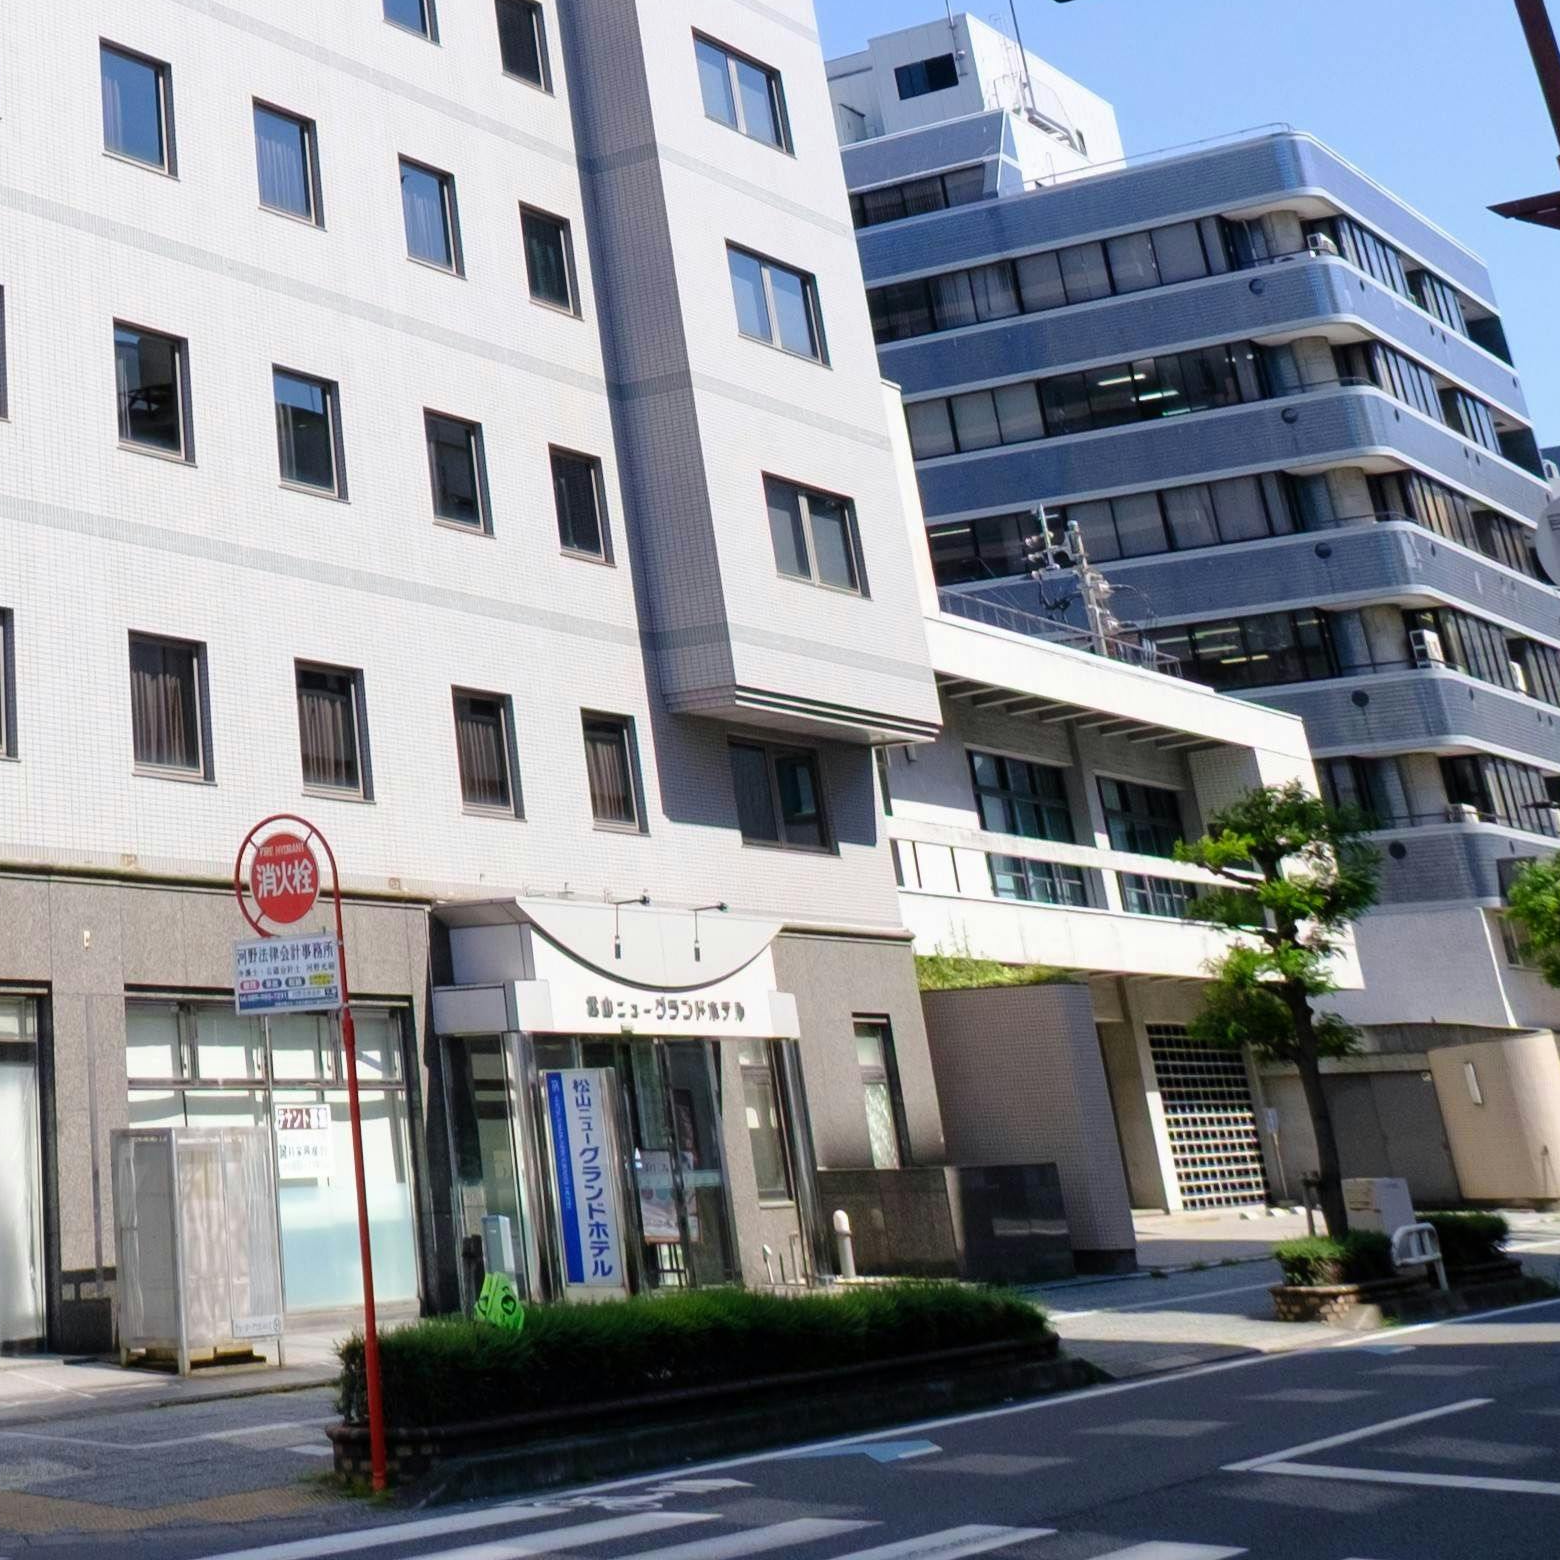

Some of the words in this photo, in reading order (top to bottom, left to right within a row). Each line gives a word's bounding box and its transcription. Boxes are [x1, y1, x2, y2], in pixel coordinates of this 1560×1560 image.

[256, 858, 315, 899] 消火栓
[571, 1077, 613, 1278] 松山ニューグランドホテル
